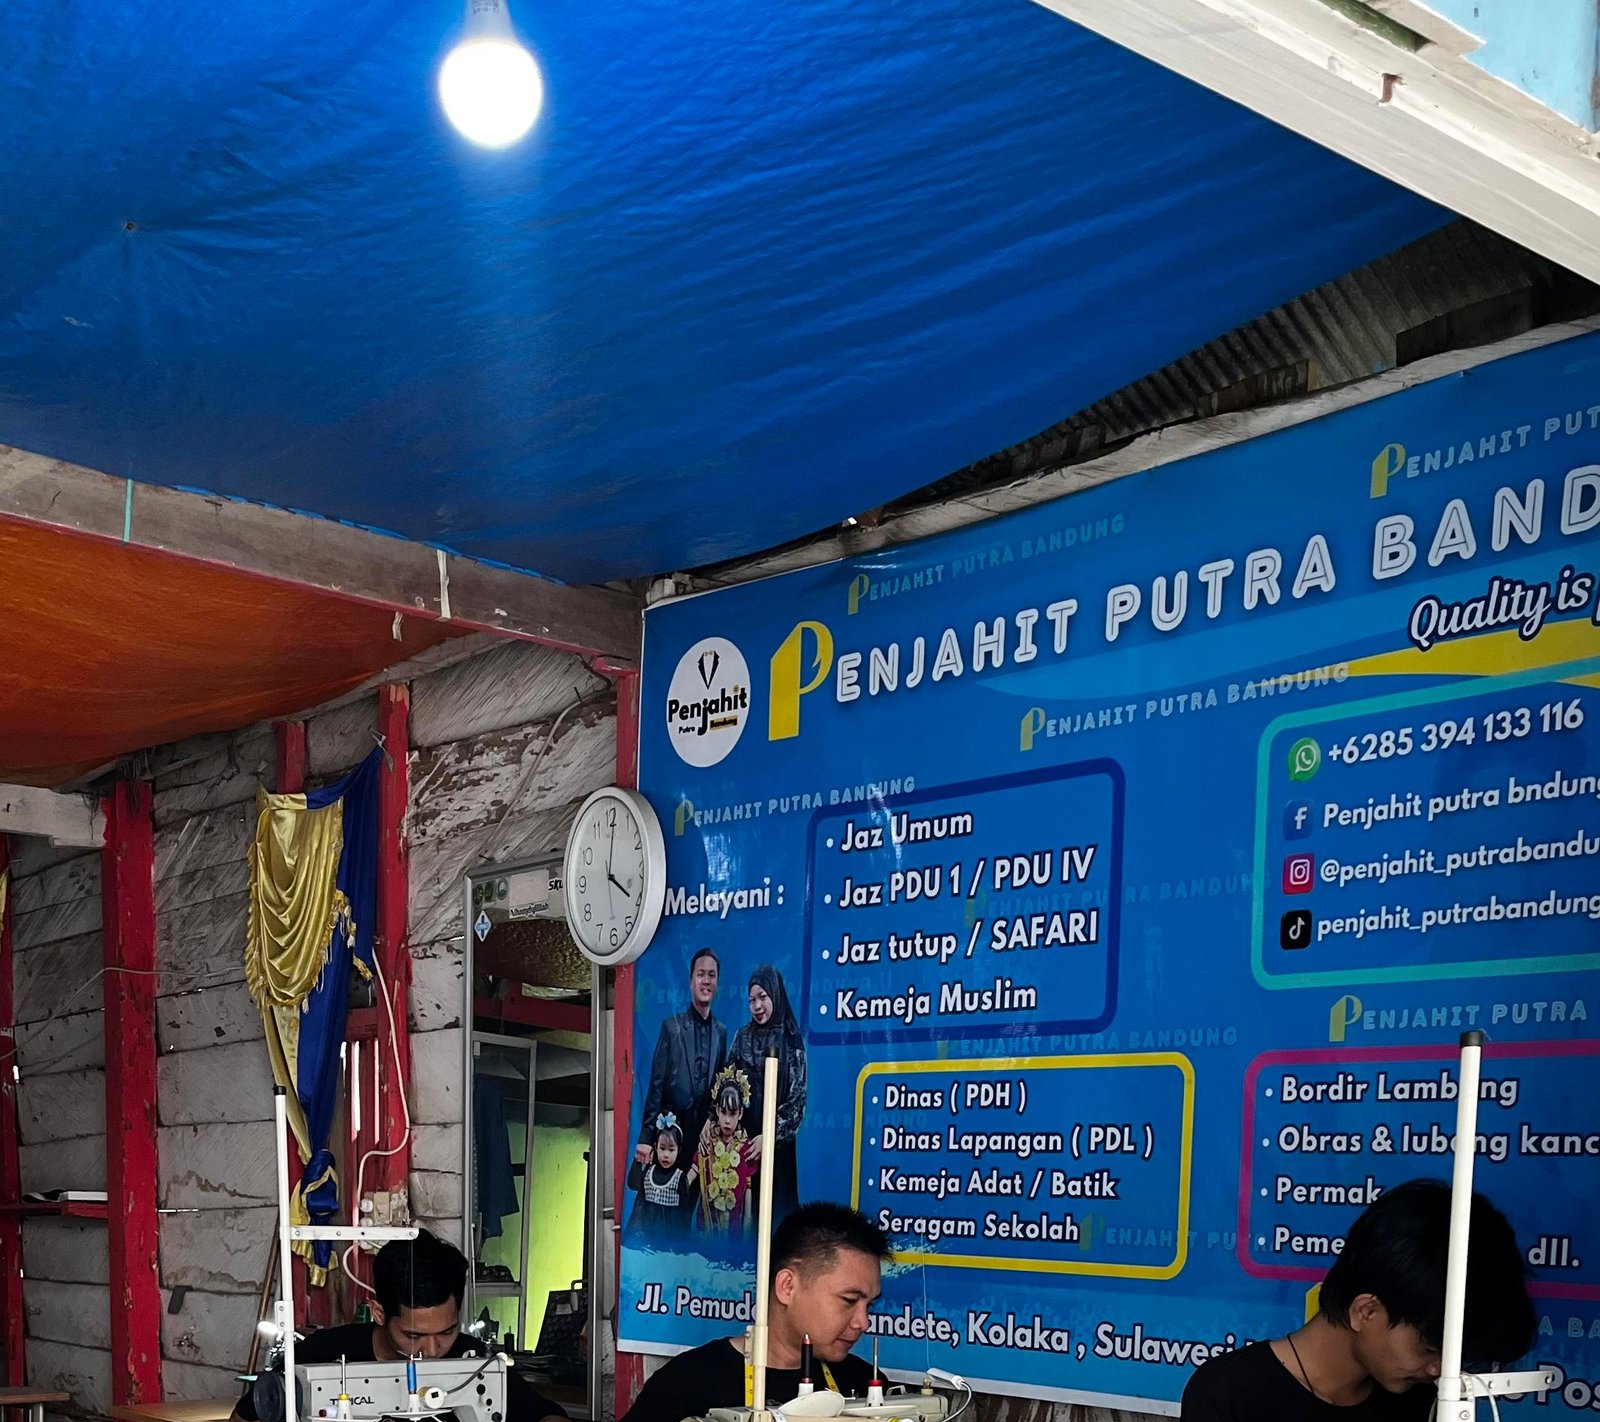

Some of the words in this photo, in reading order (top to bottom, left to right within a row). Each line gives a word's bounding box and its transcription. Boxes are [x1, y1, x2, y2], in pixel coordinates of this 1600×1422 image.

[1370, 425, 1531, 499] PENJAHIT
[848, 564, 945, 615] PENJAHIT
[952, 548, 1014, 578] PUTRA
[1021, 514, 1125, 558] BANDUNG
[768, 598, 1078, 741] PENJAHIT
[1104, 534, 1337, 642] PUTRA
[1372, 464, 1600, 580] BAND
[1412, 579, 1552, 647] Quality
[1558, 569, 1592, 611] is
[668, 685, 748, 736] Penjahit
[1020, 704, 1138, 752] PENJAHIT
[1145, 688, 1218, 720] PUTRA
[1227, 662, 1349, 704] BANDUNG
[1328, 727, 1413, 764] +6285
[1420, 717, 1475, 751] 394
[1483, 707, 1531, 742] 133
[1539, 699, 1584, 733] 116
[674, 799, 762, 836] PENJAHIT
[768, 792, 823, 815] PUTRA
[830, 777, 916, 806] BANDUNG
[1323, 793, 1421, 829] Penjahit
[1428, 789, 1500, 821] putra
[1507, 770, 1600, 804] bndun
[594, 821, 601, 840] 11
[606, 807, 617, 827] 12
[841, 822, 883, 851] Jaz
[891, 811, 973, 843] Umum
[634, 831, 642, 850] 2
[583, 847, 593, 866] 10
[579, 875, 587, 893] 9
[838, 879, 881, 908] Jaz
[890, 868, 941, 902] PDU
[969, 861, 985, 897] /
[994, 854, 1051, 889] PDU
[1062, 847, 1095, 881] IV
[584, 903, 592, 921] 8
[664, 876, 770, 920] Melayani
[596, 924, 603, 942] 7
[609, 928, 618, 946] 6
[837, 936, 880, 964] Jaz
[888, 930, 957, 963] tutup
[967, 921, 981, 957] /
[991, 910, 1098, 951] SAFARI
[836, 990, 930, 1023] Kemeja
[939, 979, 1037, 1014] Muslim
[1328, 994, 1480, 1042] PENJAHIT
[1492, 999, 1588, 1025] PUTRA
[1128, 1026, 1239, 1050] BANDUNG
[885, 1085, 943, 1109] Dinas
[966, 1084, 1010, 1107] PDH
[1282, 1074, 1368, 1101] Bordir
[1378, 1072, 1518, 1107] Lambng
[882, 1128, 941, 1151] Dinas
[948, 1127, 1062, 1157] Lapangan
[1090, 1128, 1134, 1151] PDL
[1278, 1126, 1362, 1152] Obras
[1371, 1126, 1393, 1152] &
[1521, 1125, 1600, 1154] kanc
[880, 1168, 960, 1198] Kemeja
[967, 1170, 1023, 1195] Adat
[1052, 1171, 1116, 1198] Batik
[1277, 1177, 1382, 1204] Permak
[878, 1210, 975, 1241] Seragam
[984, 1214, 1080, 1241] Sekolah
[1528, 1237, 1581, 1268] dll.
[637, 1284, 668, 1313] Jl.
[968, 1312, 1069, 1352] Kolaka
[329, 1396, 375, 1405] TICAL
